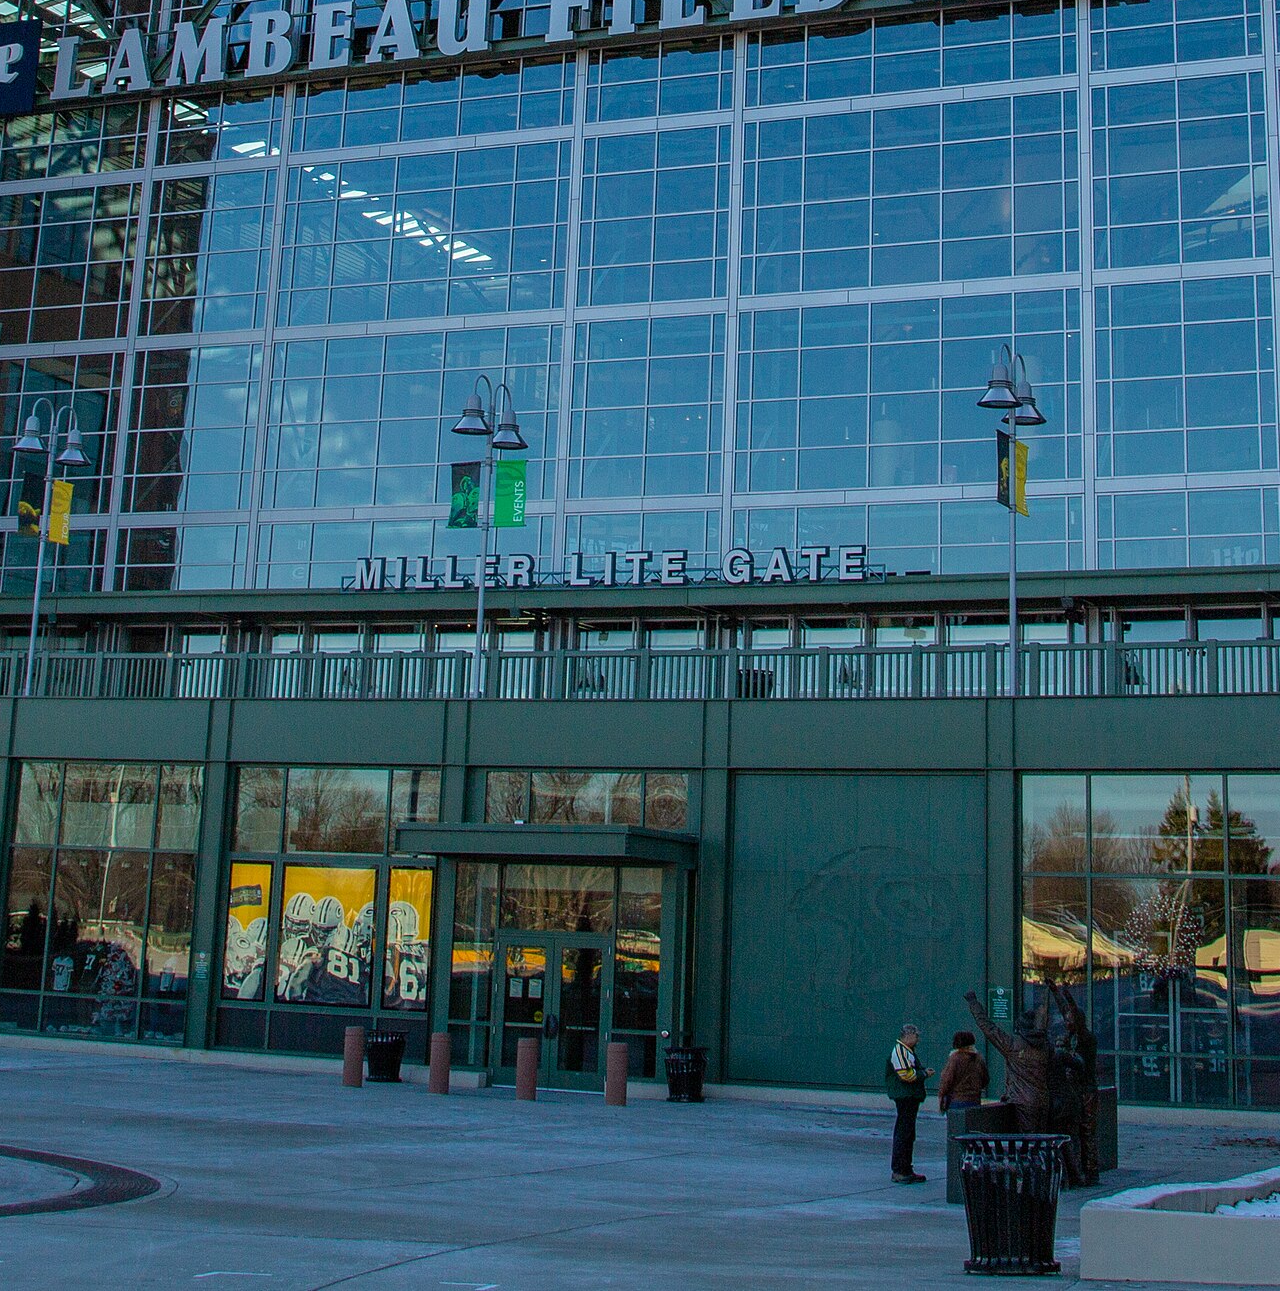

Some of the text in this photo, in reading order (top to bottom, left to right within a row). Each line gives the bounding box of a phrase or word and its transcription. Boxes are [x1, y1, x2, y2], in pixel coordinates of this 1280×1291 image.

[513, 479, 525, 523] EVENTS
[60, 512, 70, 539] TOUR
[354, 544, 869, 591] MILLER LITE GATE
[326, 948, 360, 985] 81
